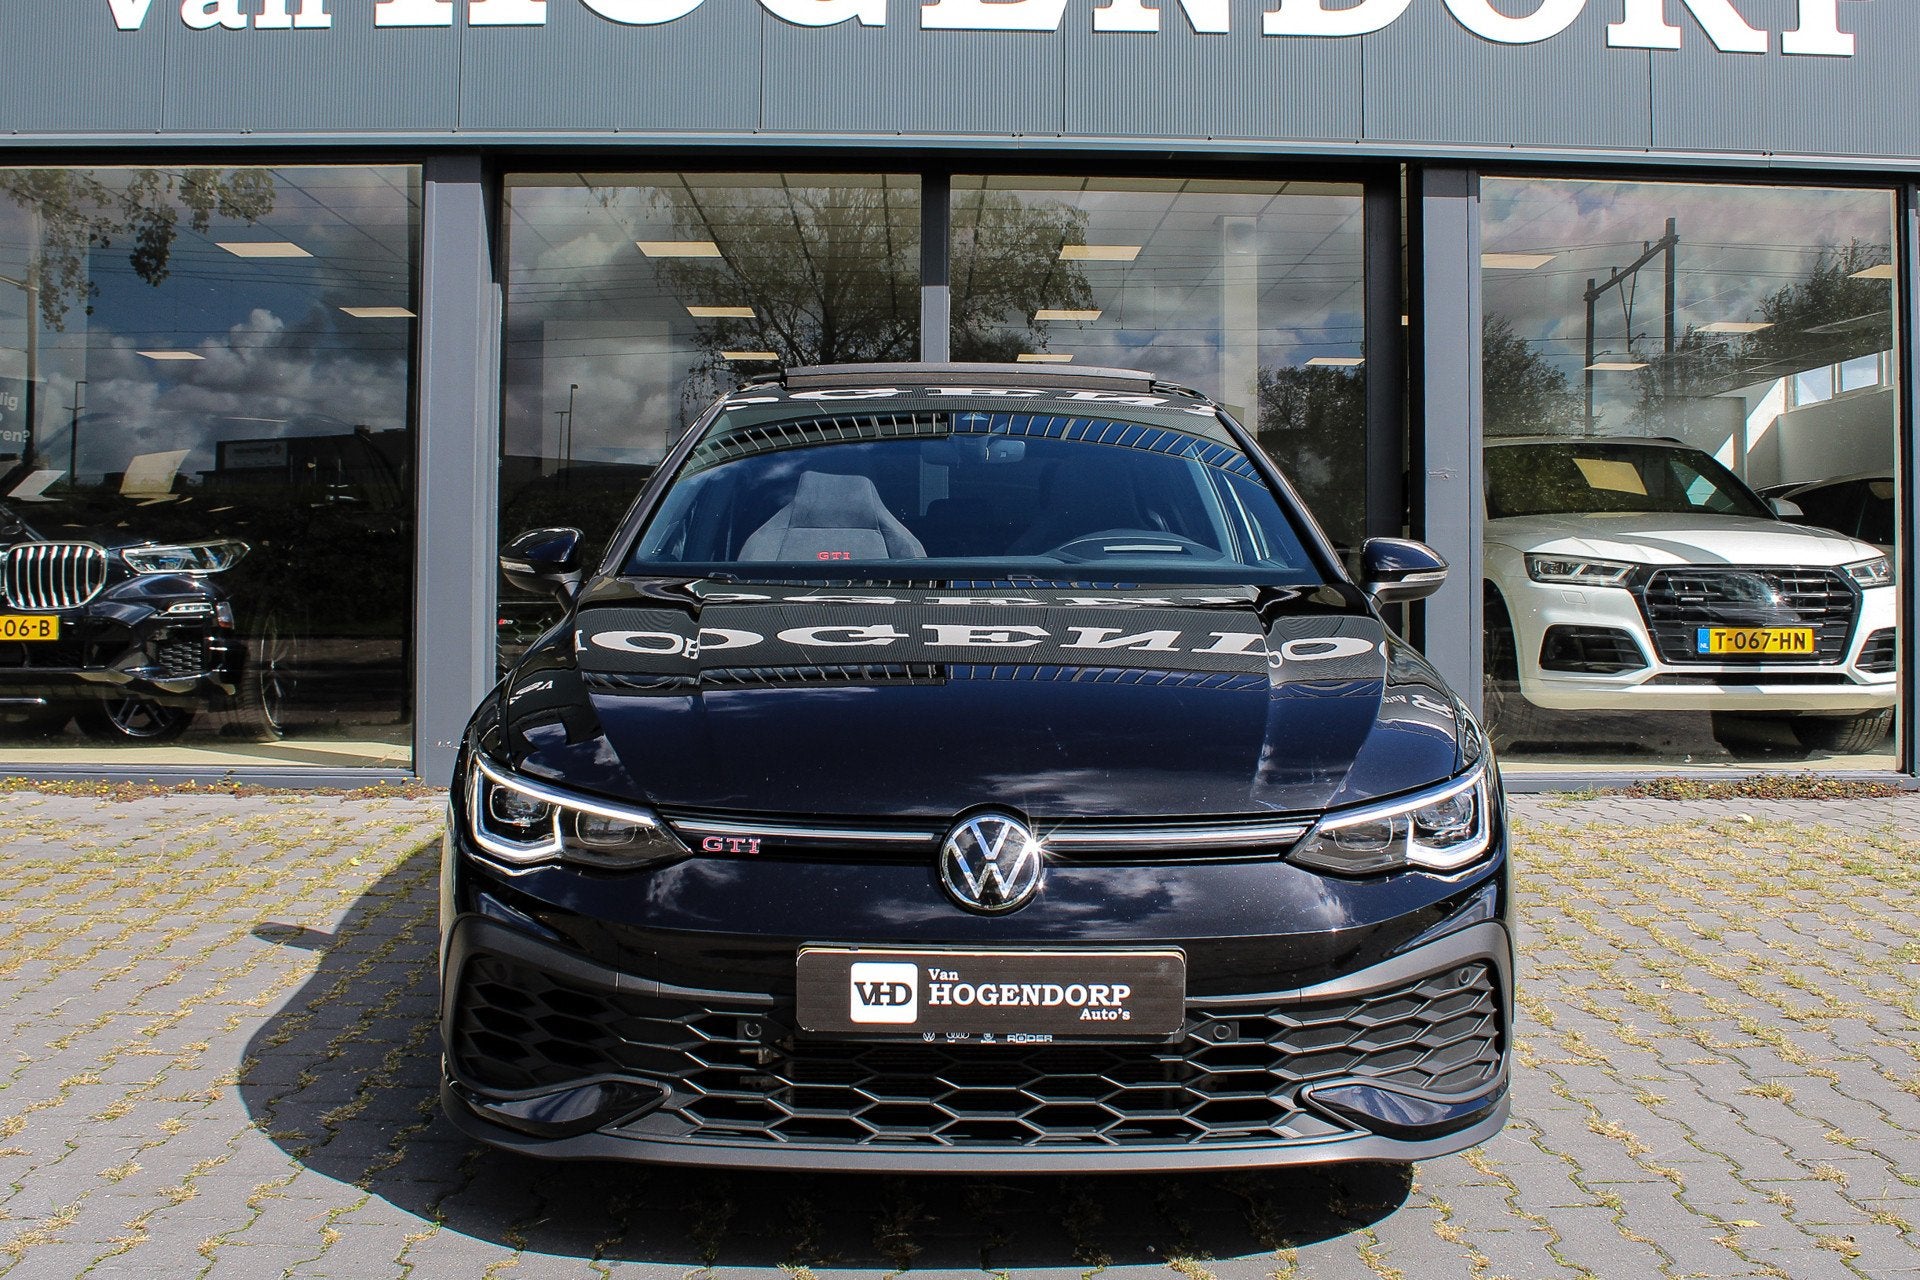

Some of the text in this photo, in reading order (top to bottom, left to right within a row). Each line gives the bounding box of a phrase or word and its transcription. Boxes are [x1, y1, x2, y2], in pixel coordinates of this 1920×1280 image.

[817, 551, 851, 561] GTI
[1714, 632, 1806, 650] T-067-HN
[702, 836, 761, 854] GTI
[928, 968, 959, 981] Van
[854, 981, 913, 1006] VHD
[928, 983, 1131, 1007] HOGENDORP
[1079, 1008, 1131, 1021] Auto's
